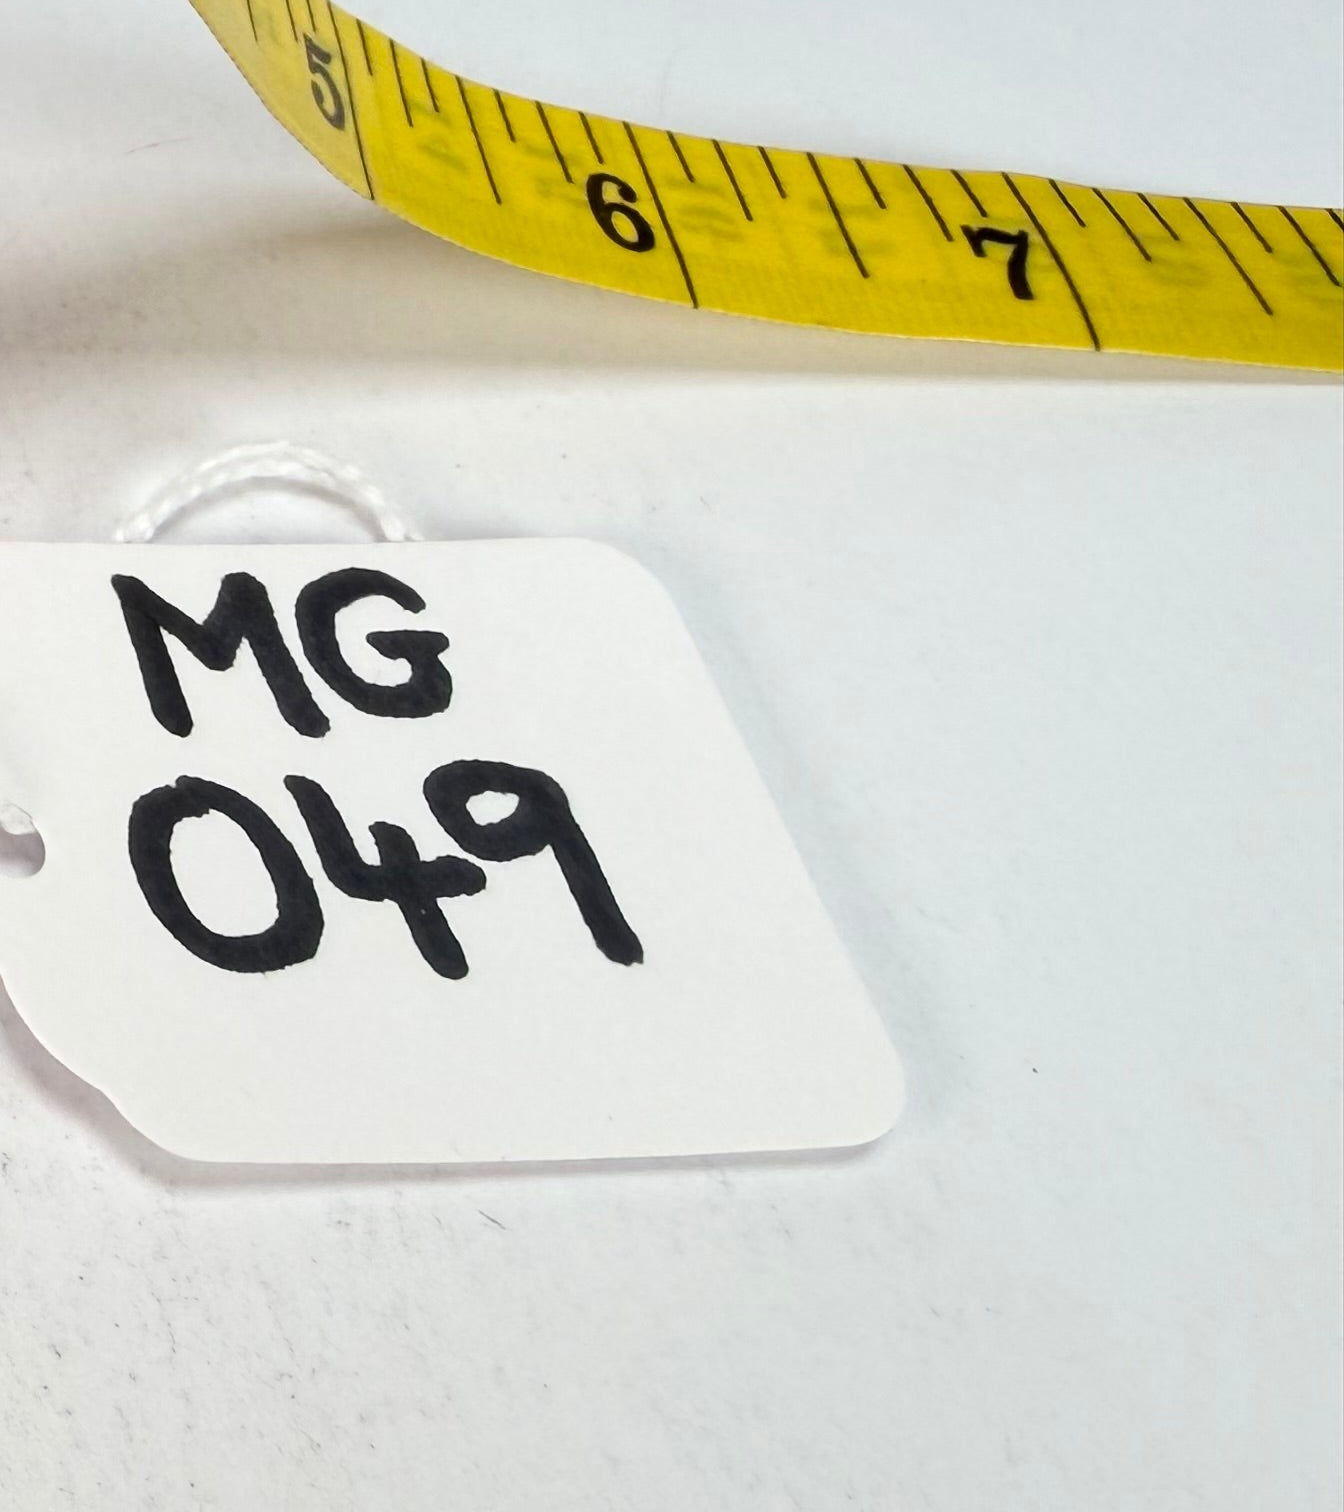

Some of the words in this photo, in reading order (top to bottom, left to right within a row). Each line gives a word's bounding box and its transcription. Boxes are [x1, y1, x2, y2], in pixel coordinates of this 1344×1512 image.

[303, 32, 346, 131] 5
[586, 173, 655, 253] 6
[961, 224, 1034, 301] 7
[111, 567, 453, 739] MG
[128, 759, 644, 981] 049
